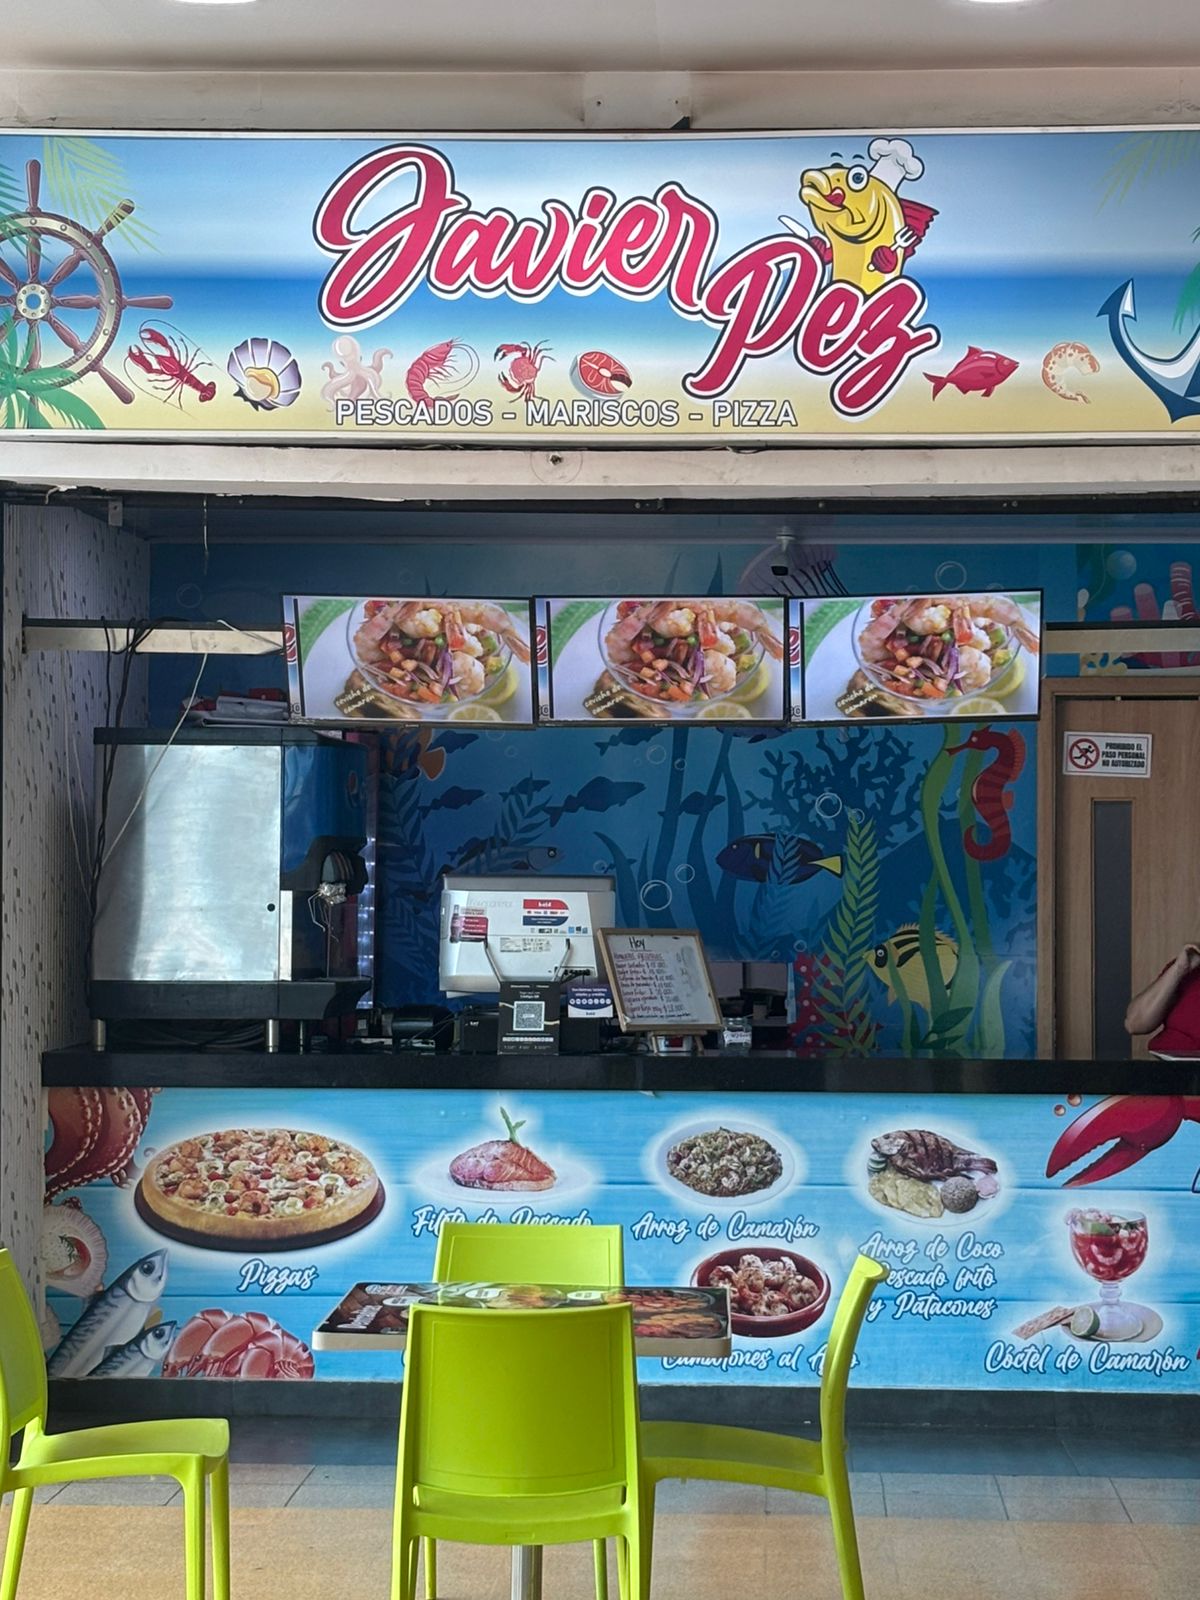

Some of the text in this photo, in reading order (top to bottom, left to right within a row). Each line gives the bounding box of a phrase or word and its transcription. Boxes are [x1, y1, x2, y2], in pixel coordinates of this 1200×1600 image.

[313, 142, 718, 329] Javier
[684, 233, 940, 416] Pez
[336, 399, 493, 426] PESCADOS
[526, 400, 679, 427] MARISCOS
[713, 400, 798, 427] PIZZA
[1105, 742, 1143, 751] PROHIBIDO EL
[1117, 751, 1145, 760] PERSONAL
[1102, 759, 1145, 768] NO AUTORIZADO
[628, 936, 646, 951] Hoy
[630, 1210, 819, 1244] Arroz de Camarón
[858, 1231, 1004, 1263] Arroz de Coco
[237, 1258, 319, 1296] Pizzas
[880, 1261, 997, 1291] escado frito
[866, 1290, 998, 1322] y Patacones
[776, 1344, 805, 1371] al
[984, 1340, 1191, 1377] Cóctel de Camarón
